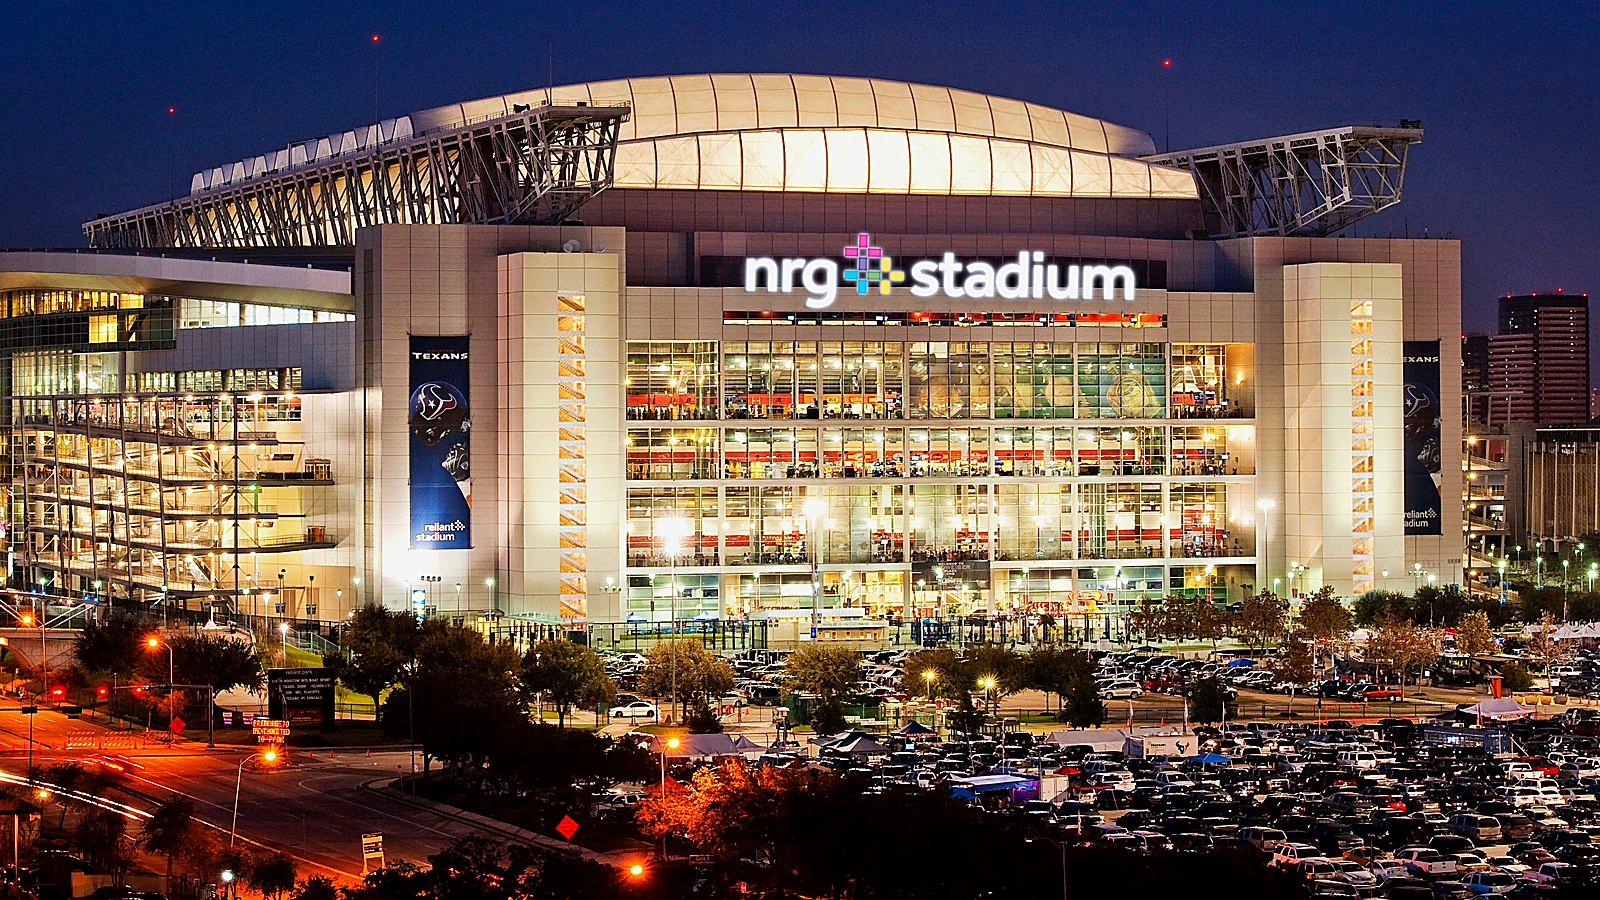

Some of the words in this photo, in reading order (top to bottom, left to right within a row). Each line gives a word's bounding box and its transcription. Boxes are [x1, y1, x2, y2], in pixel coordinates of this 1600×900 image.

[745, 257, 838, 309] nrg
[909, 251, 1135, 300] stadium
[412, 351, 468, 360] TEXANS
[1404, 509, 1429, 519] reliant
[424, 522, 455, 531] reliant
[1404, 519, 1429, 528] adium
[415, 532, 455, 541] stadium
